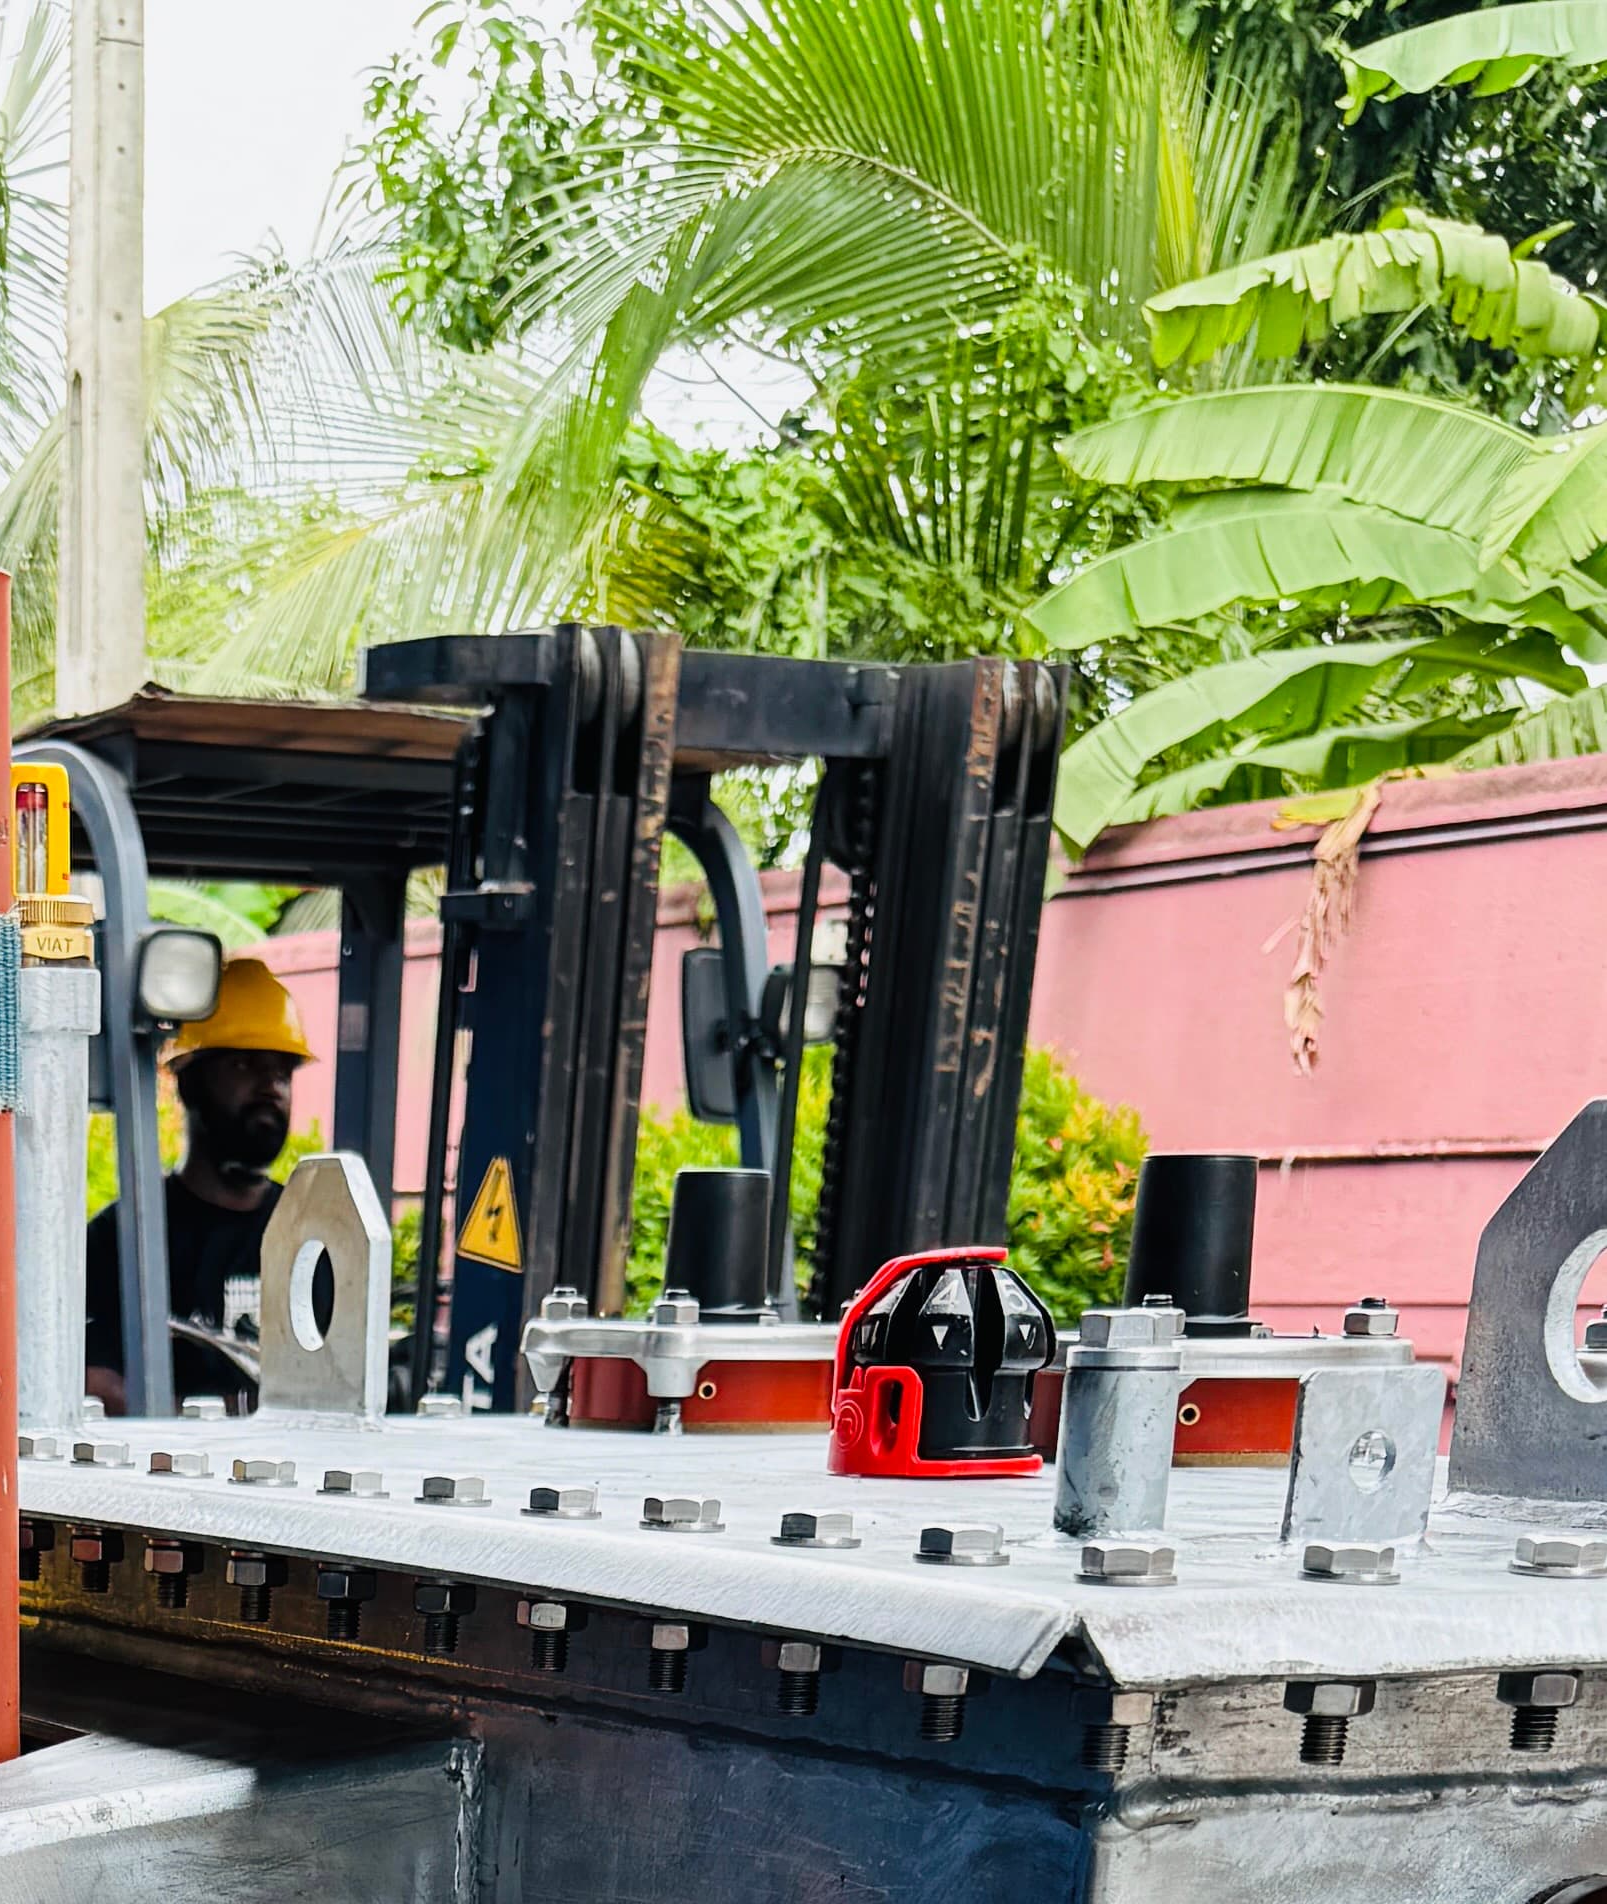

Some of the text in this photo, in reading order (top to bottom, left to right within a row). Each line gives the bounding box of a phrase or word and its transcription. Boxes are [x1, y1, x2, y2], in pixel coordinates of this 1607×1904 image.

[36, 936, 74, 953] VIAT
[931, 1279, 958, 1306] 4
[1003, 1283, 1028, 1311] 5
